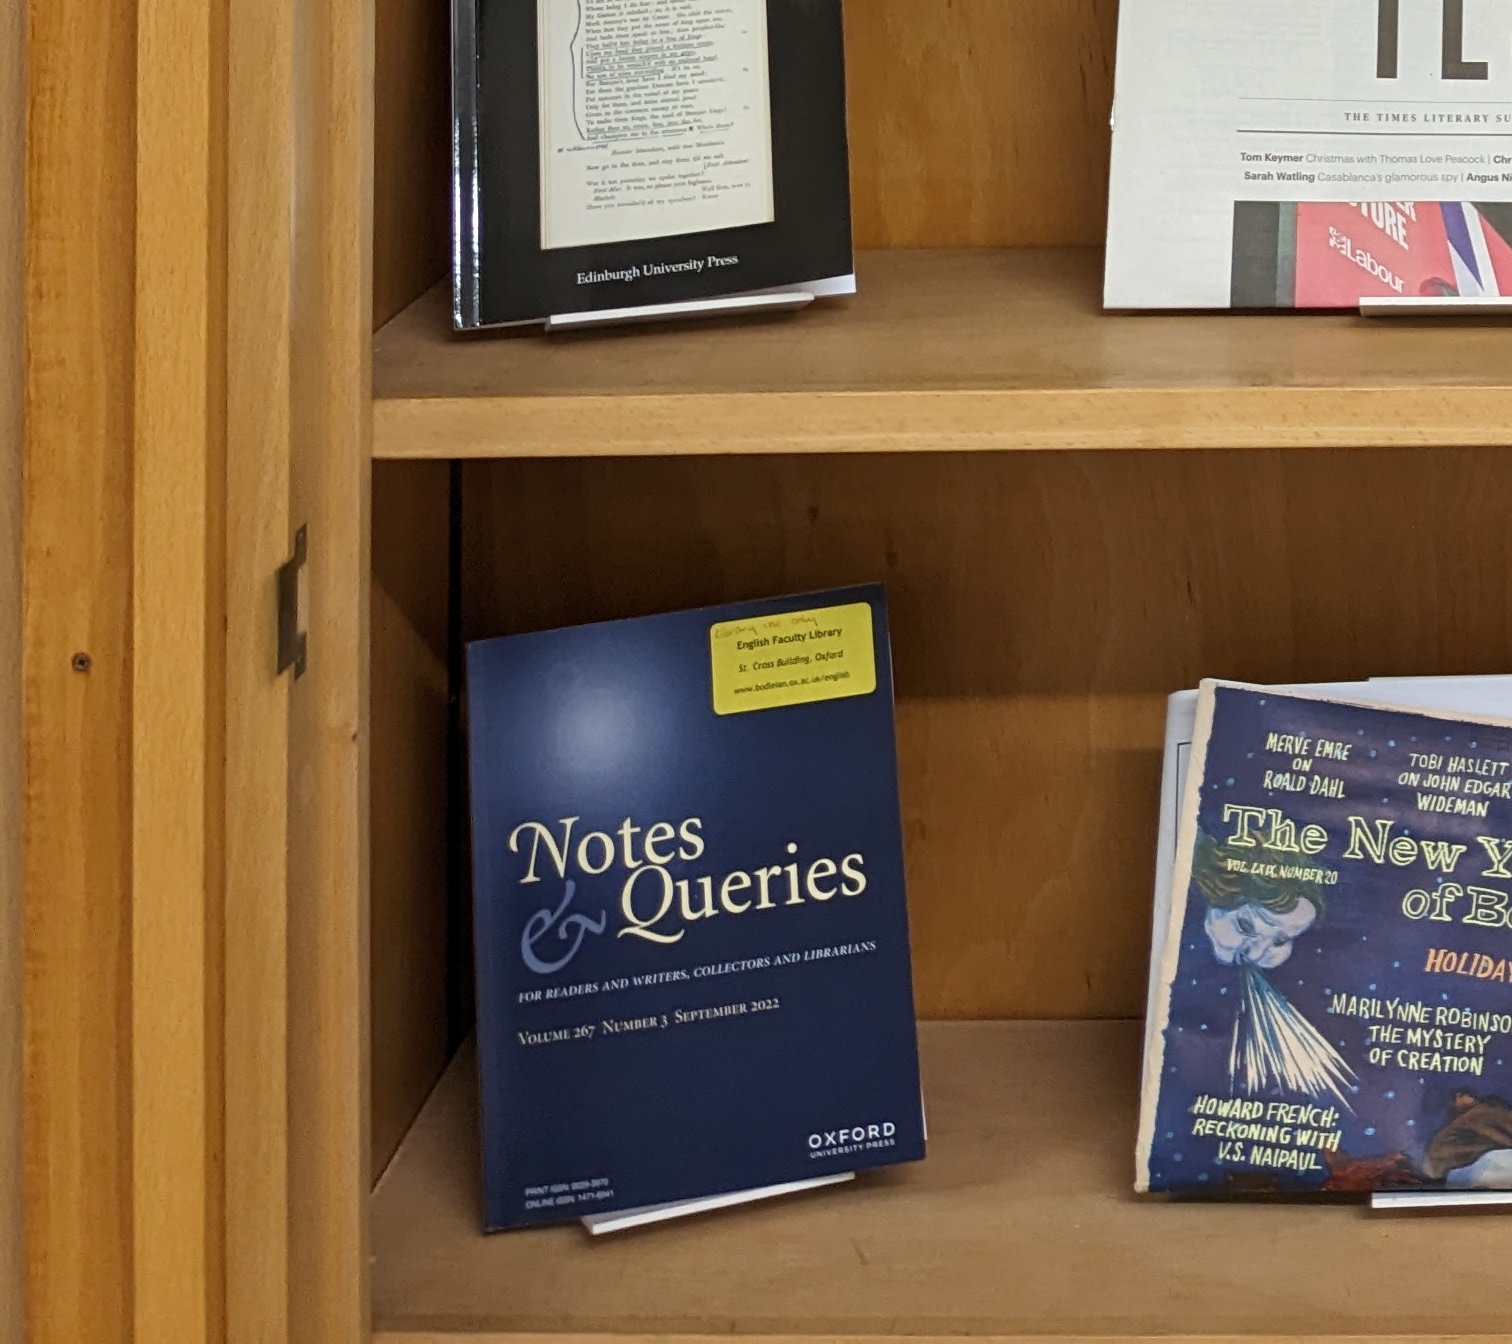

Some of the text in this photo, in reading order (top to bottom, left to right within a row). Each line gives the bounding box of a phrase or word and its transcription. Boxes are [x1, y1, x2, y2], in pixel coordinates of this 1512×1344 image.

[1344, 111, 1370, 122] THE
[1377, 112, 1417, 123] TIMES
[1423, 113, 1490, 124] LITERARY
[577, 253, 739, 284] Edinburgh University Press
[1348, 246, 1405, 295] Labour
[508, 816, 706, 884] Notes
[1223, 804, 1328, 854] The
[1344, 817, 1466, 873] New
[520, 843, 868, 975] & Queries
[1401, 882, 1464, 923] of
[519, 941, 876, 1003] FOR READERS AND WRITERS, COLLECTORS AND LIBRARIANS
[574, 1025, 595, 1041] 267
[660, 1016, 668, 1029] 3
[751, 997, 779, 1012] 2022
[808, 1122, 895, 1150] OXFORD
